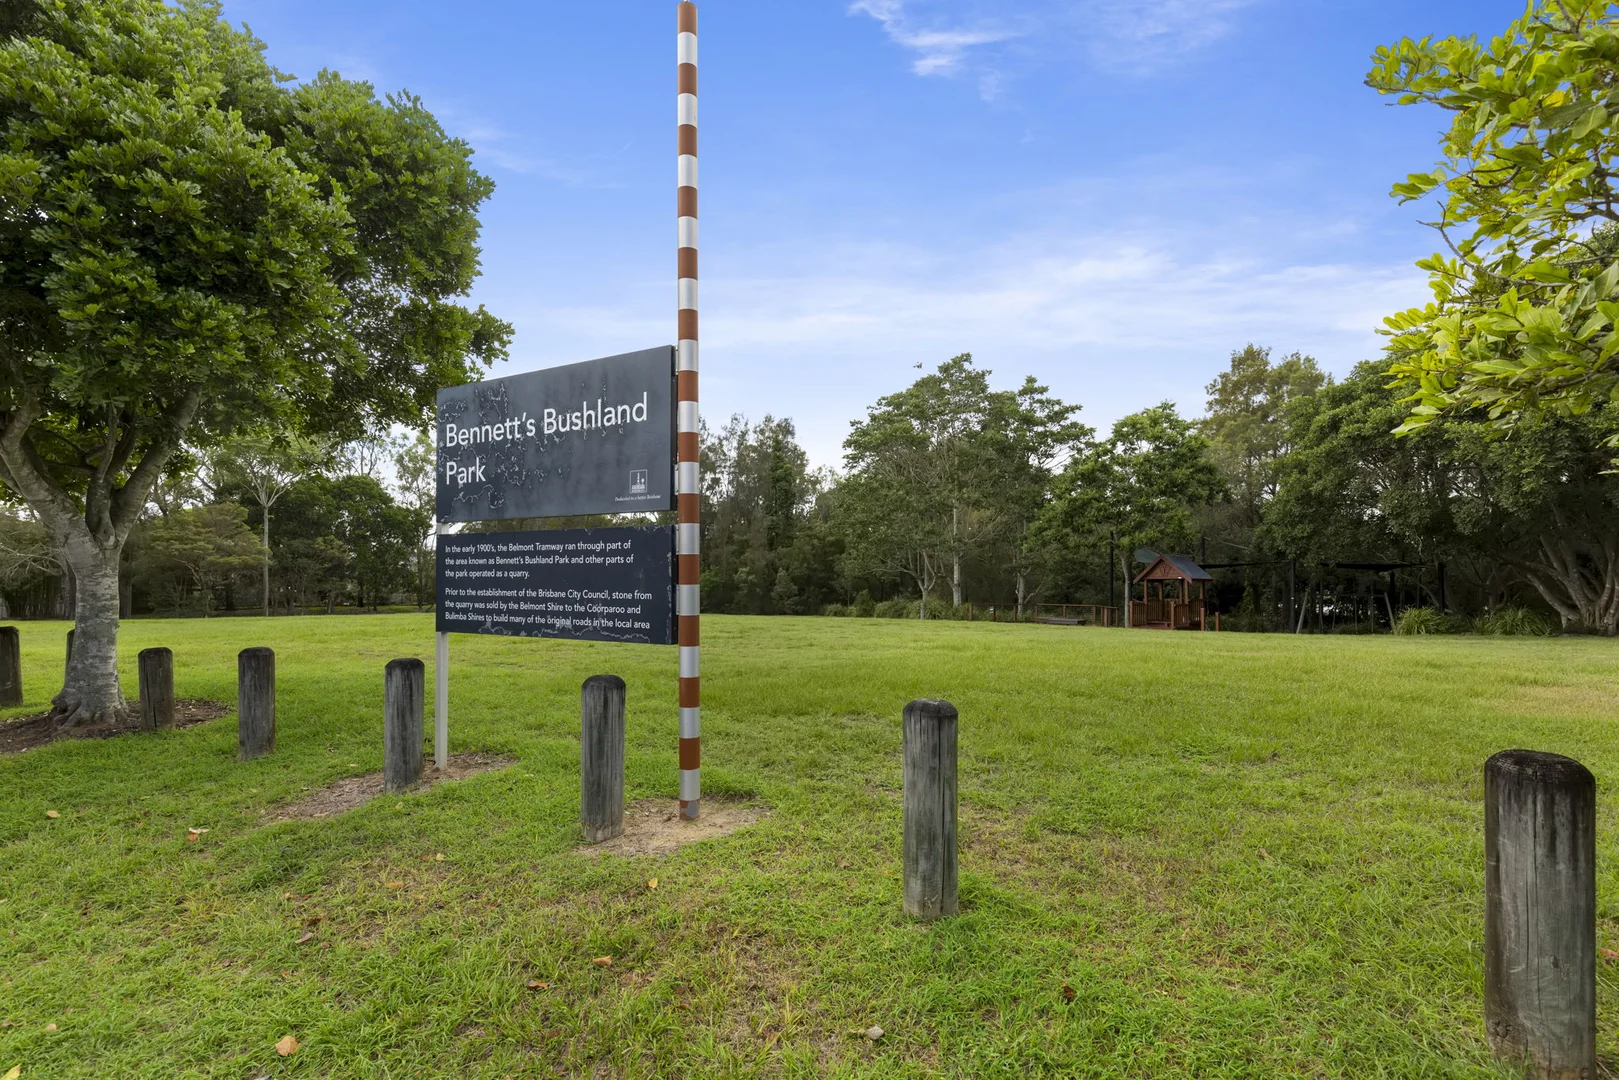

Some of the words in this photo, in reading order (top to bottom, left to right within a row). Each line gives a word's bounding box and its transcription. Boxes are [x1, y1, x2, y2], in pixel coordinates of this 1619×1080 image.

[446, 412, 536, 447] Bennett's
[544, 391, 647, 435] Bushland
[446, 457, 486, 485] Park
[462, 545, 475, 554] early
[477, 544, 496, 552] 1900's,
[509, 543, 534, 551] Belmont
[536, 543, 563, 552] Tramway
[578, 540, 604, 551] through
[607, 542, 621, 552] part
[623, 540, 631, 549] of
[525, 556, 553, 564] Bushland
[555, 555, 569, 564] Park
[571, 555, 583, 564] and
[585, 554, 603, 563] other
[606, 555, 624, 566] parts
[626, 554, 634, 563] of
[456, 569, 468, 579] park
[469, 569, 495, 579] operated
[509, 571, 529, 579] quarry.
[477, 588, 517, 596] establishment
[519, 588, 525, 597] of
[526, 589, 536, 597] the
[538, 589, 566, 598] Brisbane
[568, 590, 581, 600] City
[583, 590, 610, 599] Council,
[634, 590, 652, 600] from
[500, 601, 507, 611] by
[520, 602, 545, 610] Belmont
[548, 603, 563, 611] Shire
[574, 604, 585, 612] the
[587, 604, 625, 615] Coorparoo
[627, 605, 640, 614] and
[445, 612, 466, 620] Bulimba
[494, 613, 508, 622] build
[510, 616, 525, 625] many
[547, 616, 571, 627] original
[573, 618, 591, 626] roads
[602, 618, 613, 627] the
[615, 619, 632, 628] local
